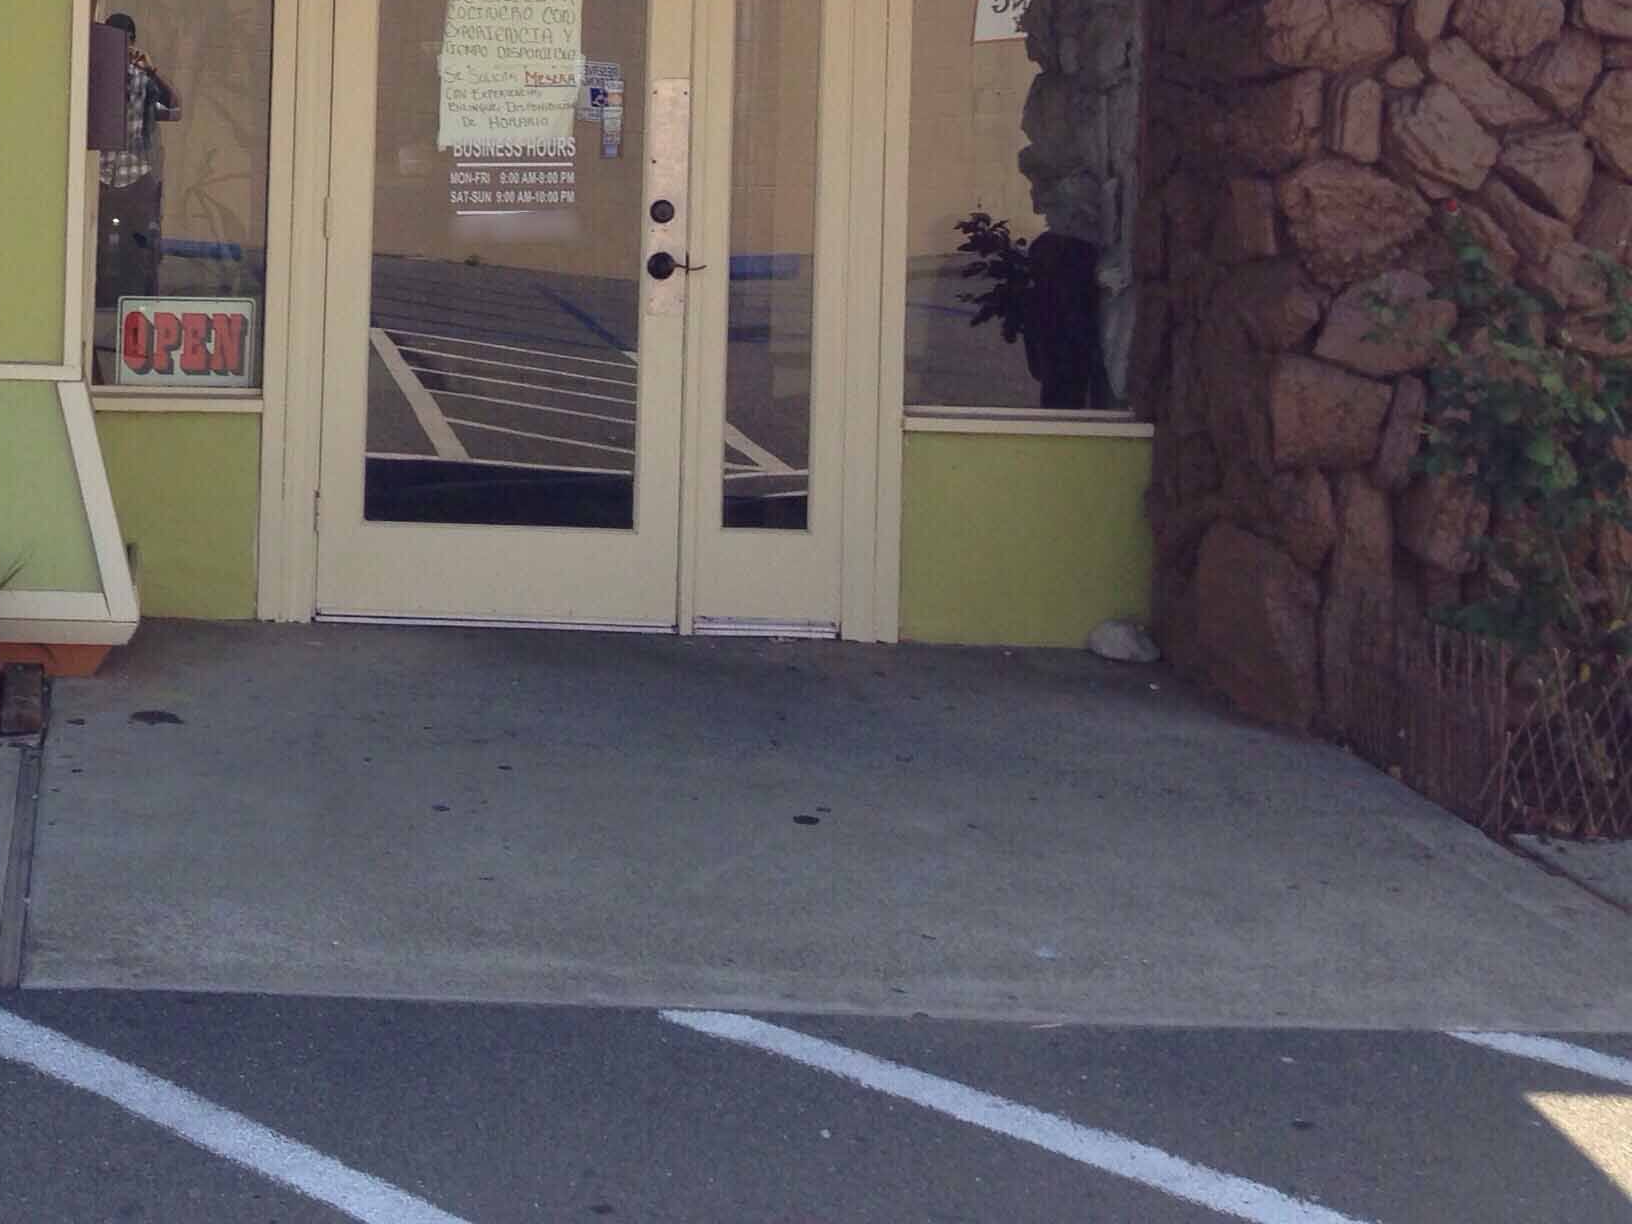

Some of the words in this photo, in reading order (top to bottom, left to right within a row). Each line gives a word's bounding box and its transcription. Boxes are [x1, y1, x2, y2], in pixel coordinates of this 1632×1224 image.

[448, 5, 533, 23] COCINERO
[542, 6, 576, 25] CON
[562, 27, 574, 43] Y
[453, 136, 523, 158] BUSINESS
[527, 136, 577, 158] HOURS
[449, 171, 491, 185] MON-FRI
[560, 171, 576, 185] PM
[449, 191, 492, 204] SAT-SUN
[560, 191, 576, 204] PM
[123, 311, 247, 376] OPEN
